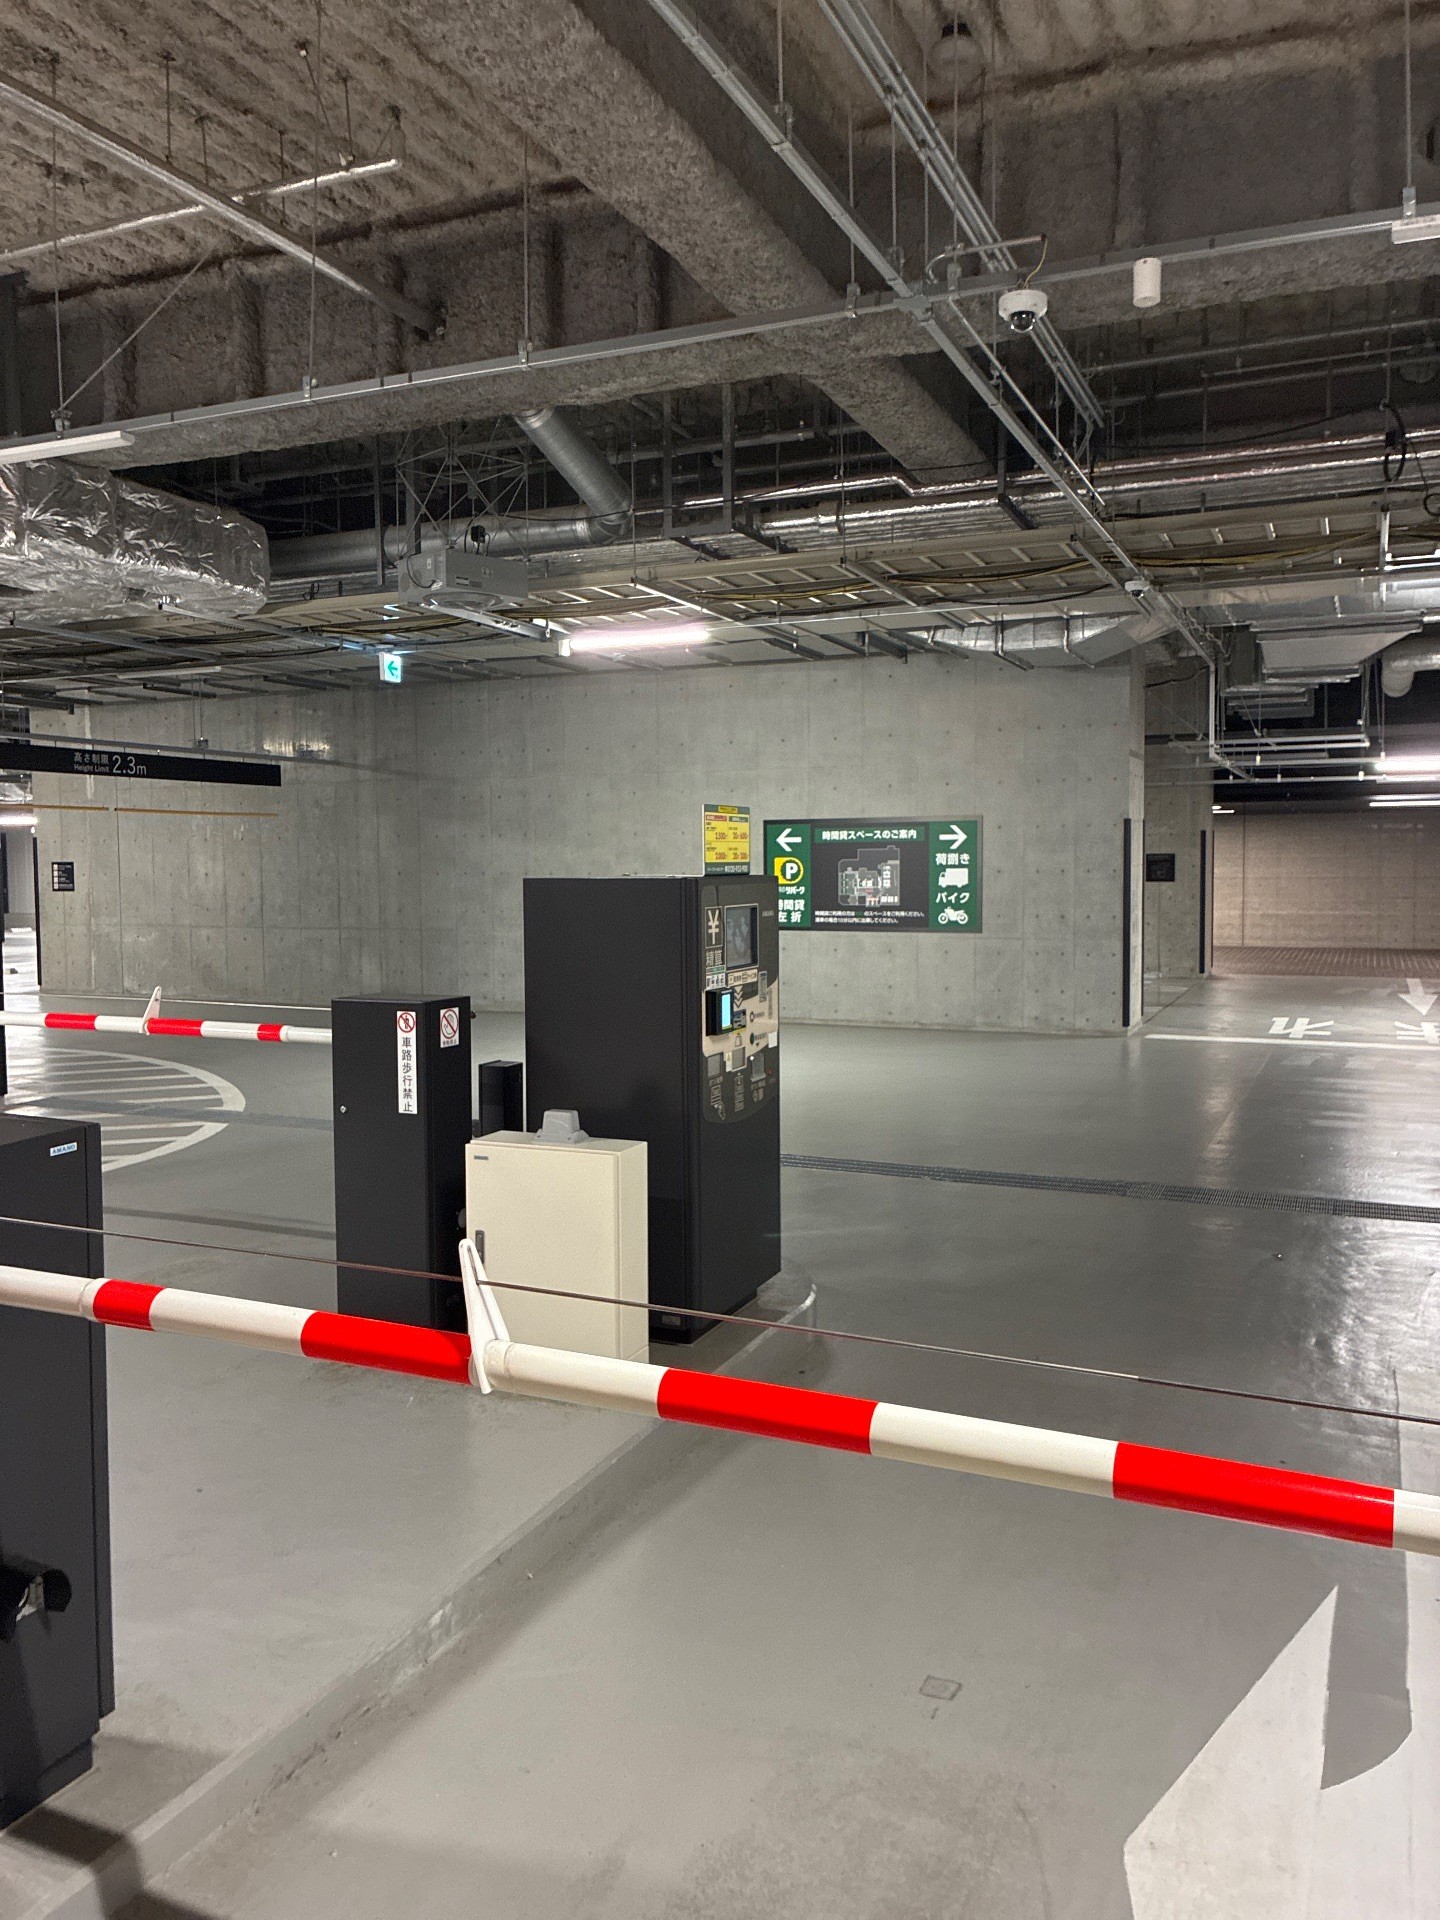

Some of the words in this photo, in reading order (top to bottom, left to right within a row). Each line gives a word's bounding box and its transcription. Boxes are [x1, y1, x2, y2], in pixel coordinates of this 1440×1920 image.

[74, 752, 109, 765] 高さ制限
[112, 755, 147, 776] 2.3m
[822, 829, 917, 841] 時間貸スペースのご案内
[935, 852, 970, 865] 荷捌き
[935, 892, 970, 904] バイク
[401, 1036, 413, 1112] 車路歩行禁止
[52, 1144, 76, 1154] AMANO
